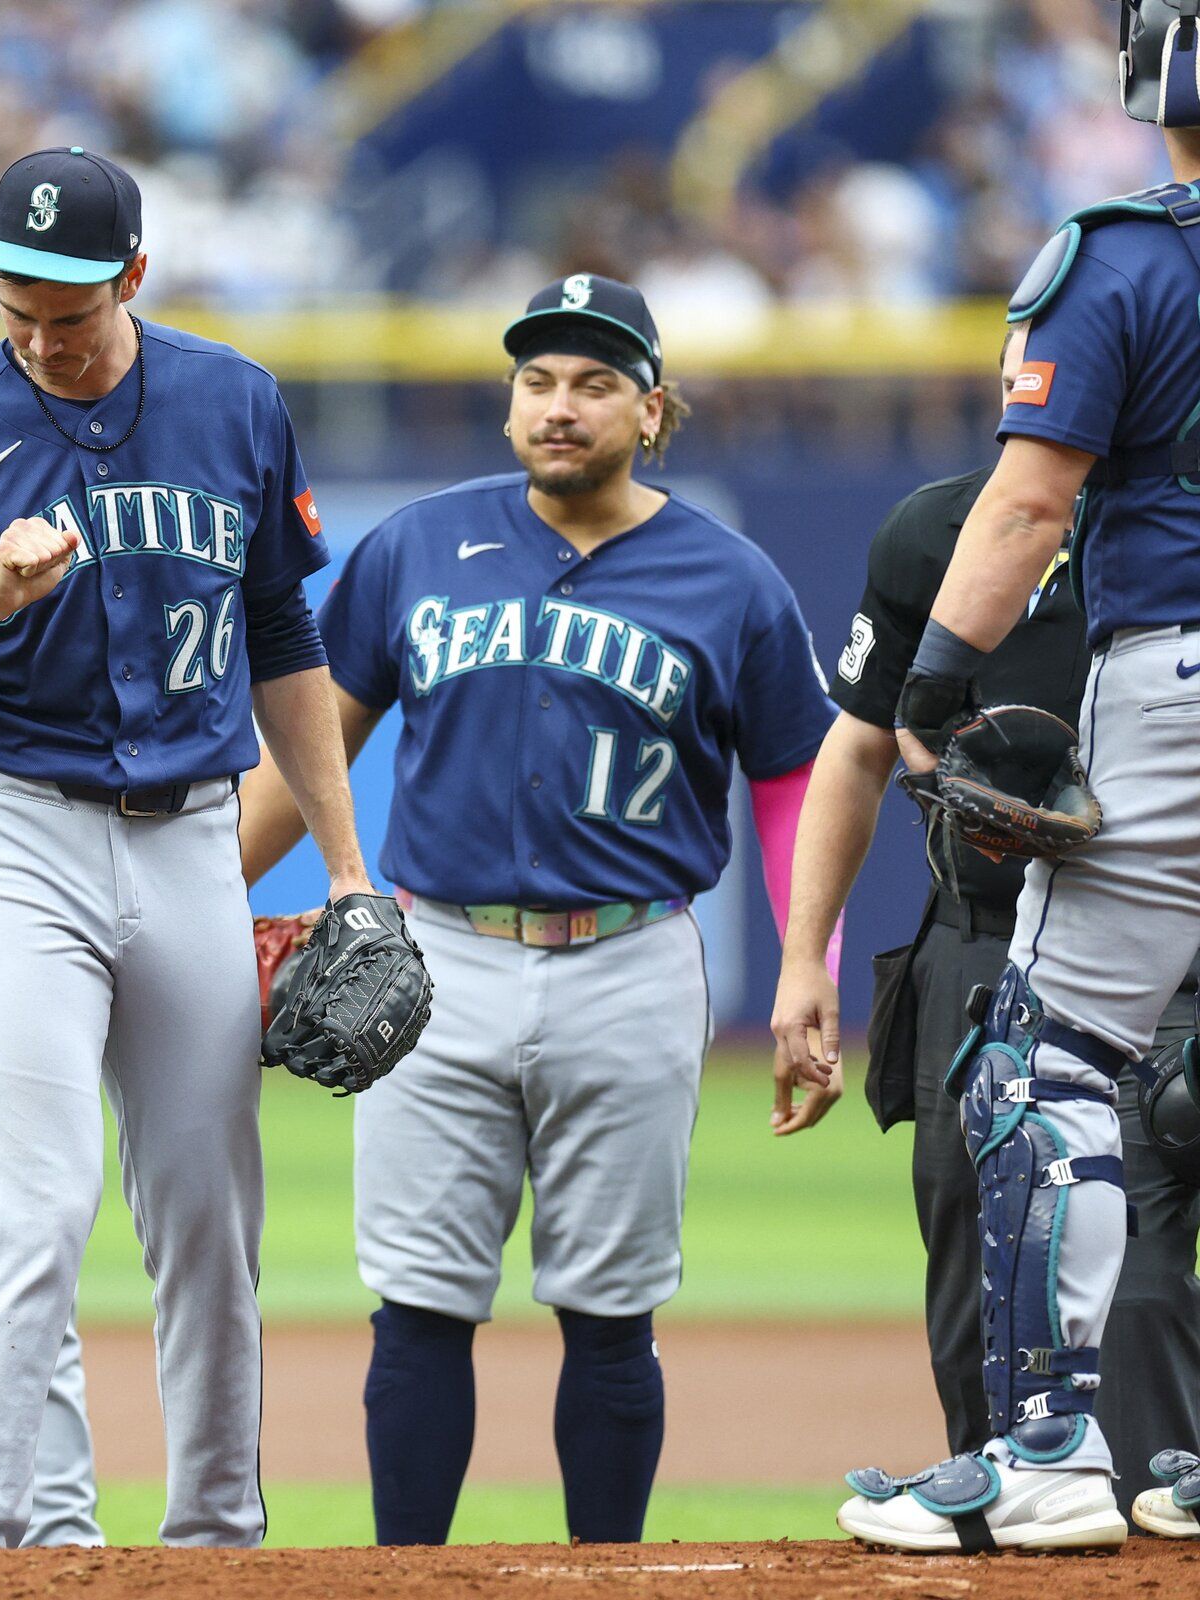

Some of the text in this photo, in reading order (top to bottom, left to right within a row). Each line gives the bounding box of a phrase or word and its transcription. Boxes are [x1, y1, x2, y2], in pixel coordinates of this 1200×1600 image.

[26, 182, 61, 232] S
[562, 273, 594, 310] S
[163, 585, 237, 695] 26
[406, 595, 692, 729] SEATTLE
[838, 612, 876, 685] 3
[573, 725, 679, 826] 12
[576, 917, 593, 938] 12
